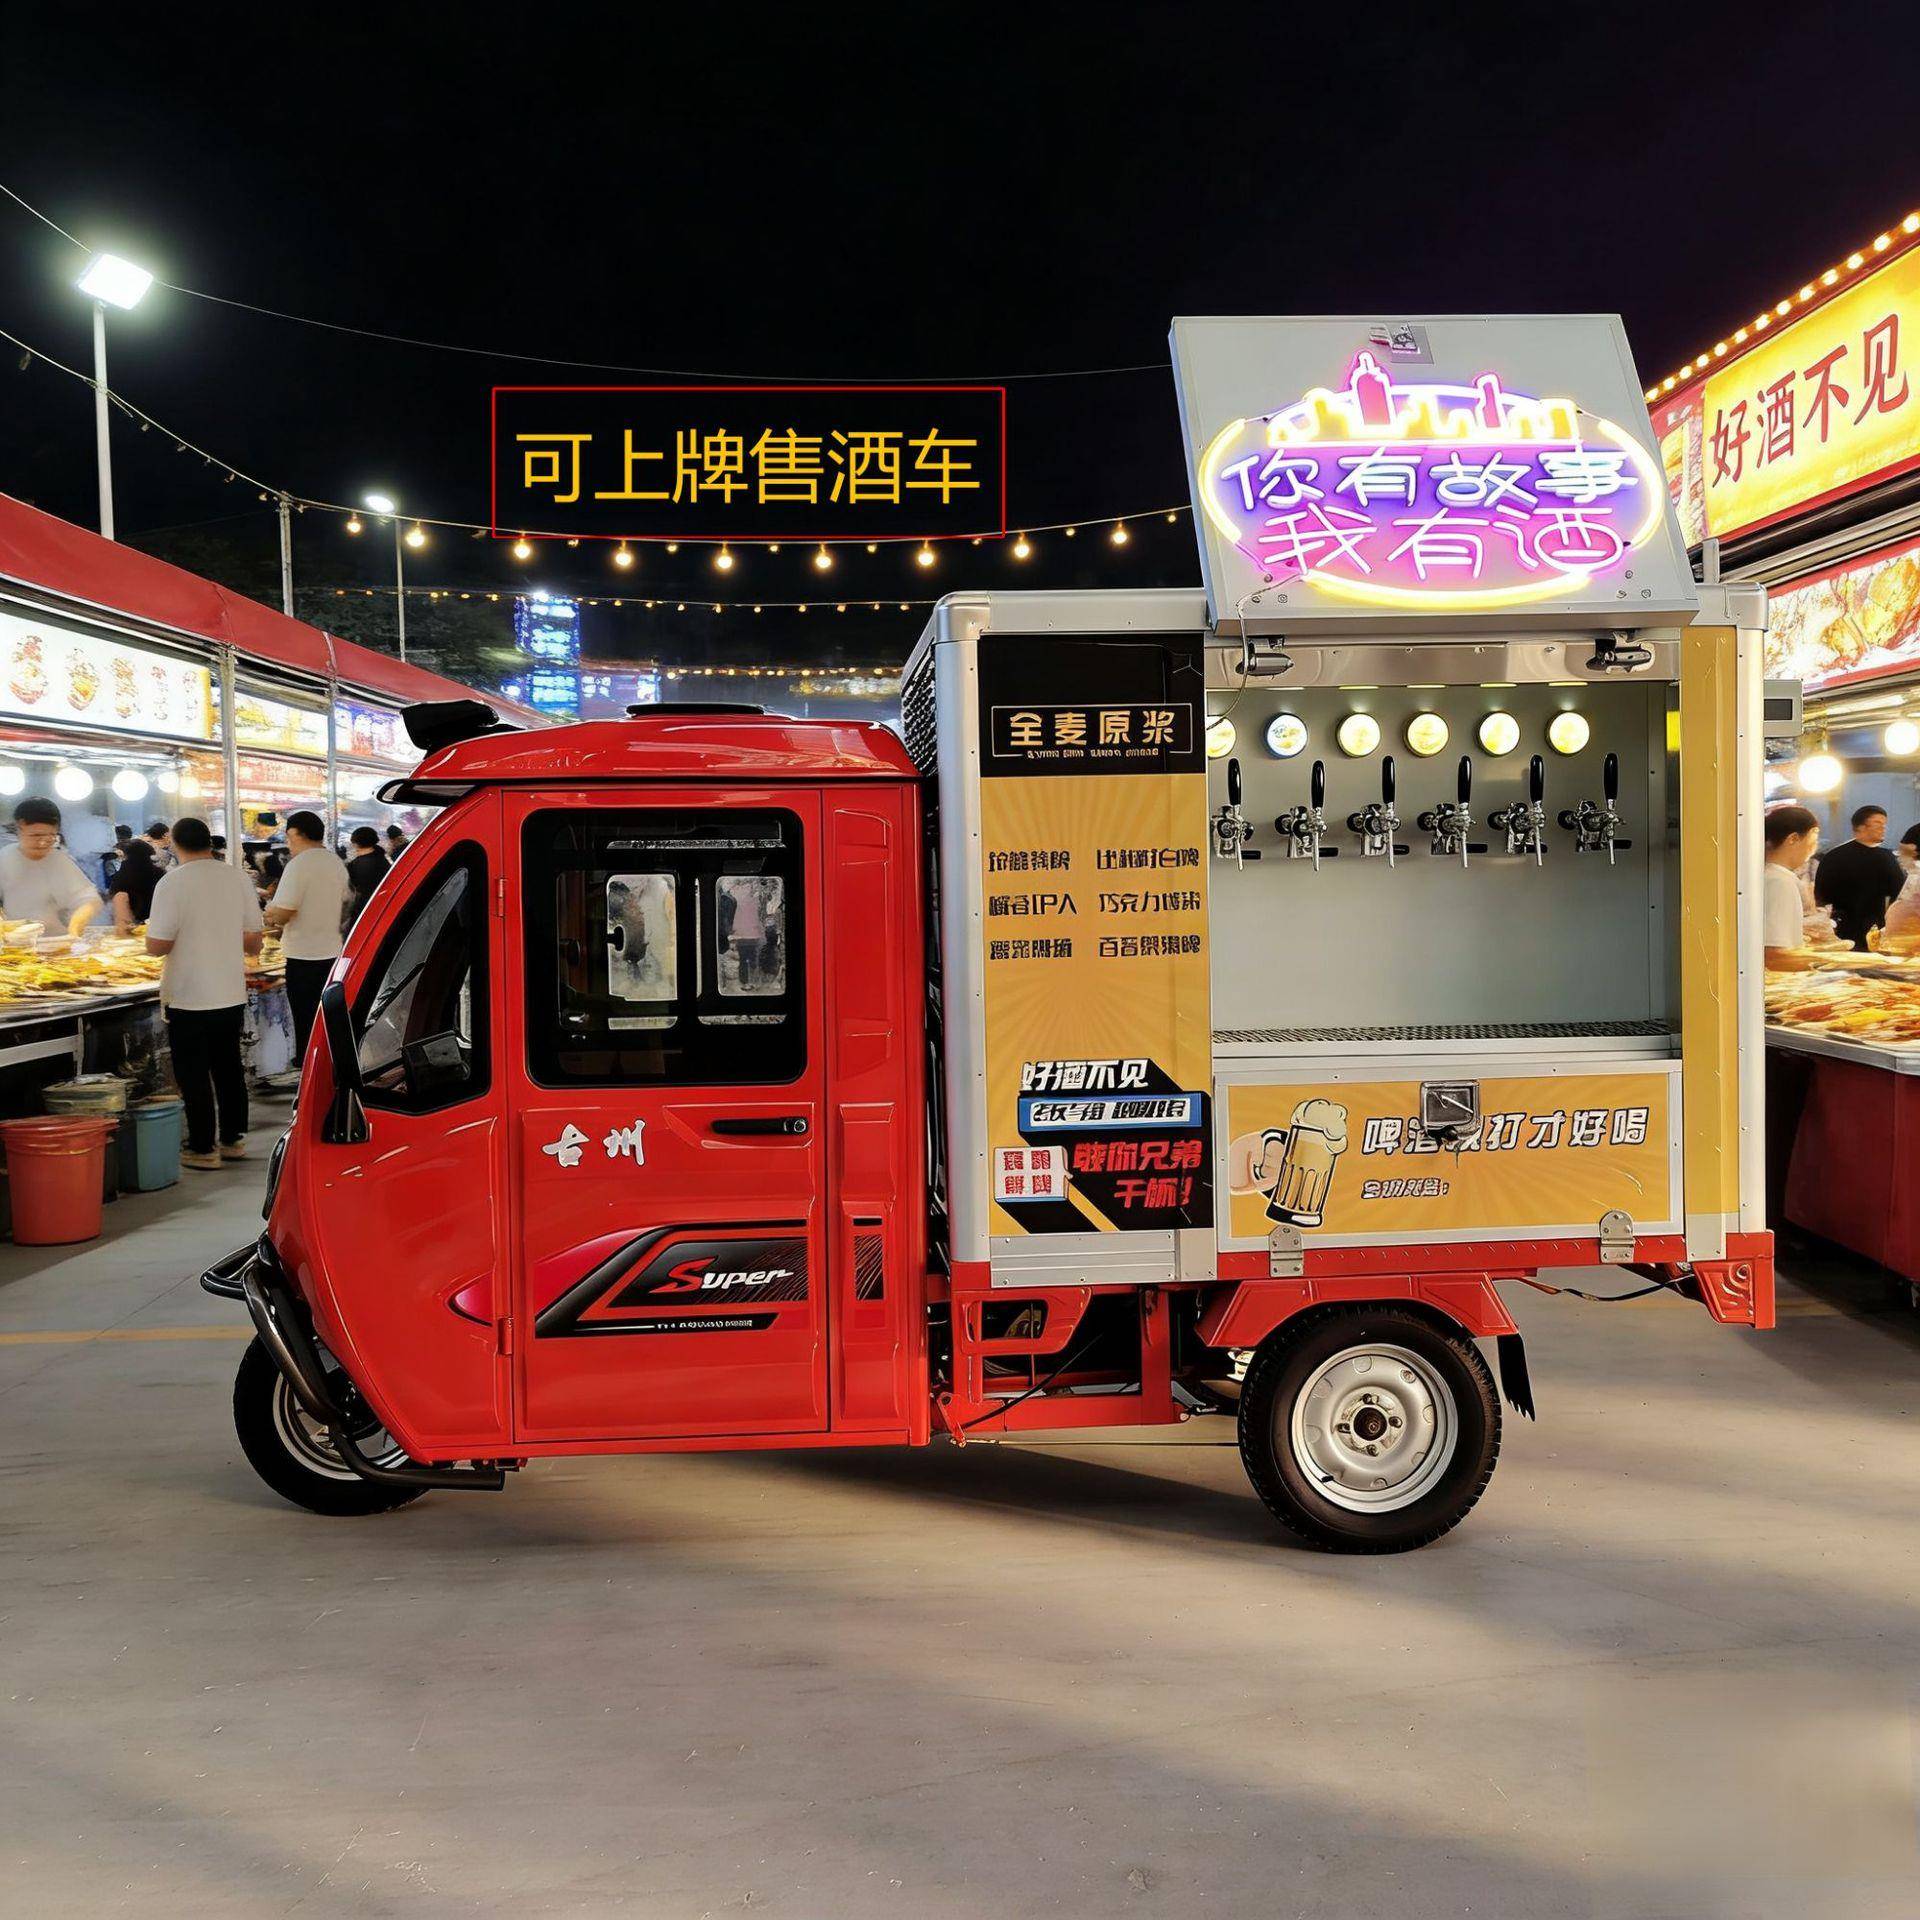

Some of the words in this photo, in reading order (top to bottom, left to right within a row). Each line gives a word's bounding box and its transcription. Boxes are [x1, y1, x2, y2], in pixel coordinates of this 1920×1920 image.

[1711, 313, 1910, 488] 好酒不见
[1221, 441, 1639, 511] 你有故事
[1257, 502, 1624, 581] 我有酒
[1010, 710, 1175, 746] 全麦原浆
[1021, 1059, 1149, 1091] 好酒不见
[649, 1256, 794, 1293] Super
